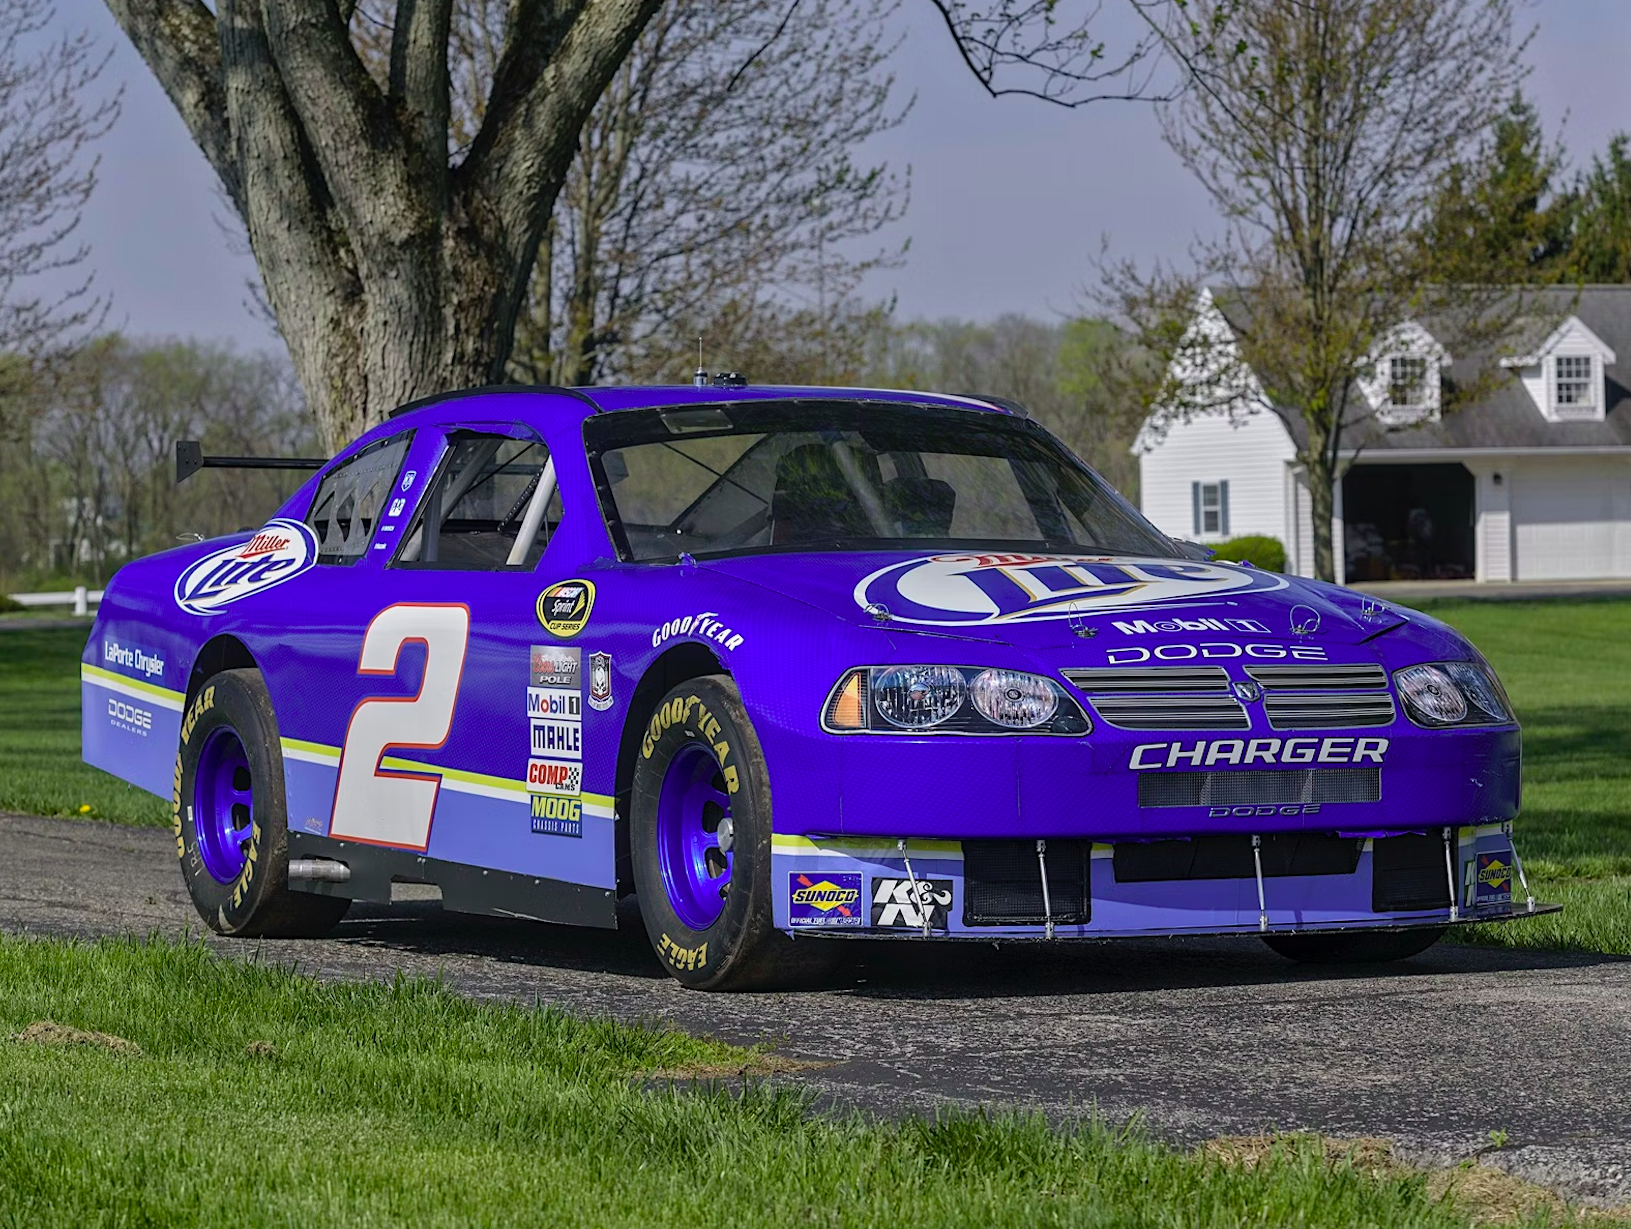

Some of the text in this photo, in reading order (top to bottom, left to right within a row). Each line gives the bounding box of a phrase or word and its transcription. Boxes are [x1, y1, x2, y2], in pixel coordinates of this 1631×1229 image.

[236, 533, 290, 559] Miller
[181, 554, 296, 602] Lite
[551, 599, 576, 617] Sprint
[549, 622, 581, 631] CUP SERIES
[651, 611, 745, 652] GOODYEAR
[1111, 618, 1230, 635] Mobil
[105, 640, 164, 677] LaPorte Chrysler
[1106, 642, 1328, 664] DODGE
[554, 659, 578, 674] LIGHT
[539, 674, 572, 685] POLE
[108, 698, 152, 730] DODGE
[528, 692, 566, 715] Mobil
[569, 695, 580, 715] 1
[110, 718, 148, 737] DEALERS
[328, 602, 471, 854] 2
[533, 724, 580, 752] MAHLE
[642, 694, 741, 796] GOODYEAR
[1128, 737, 1389, 770] CHARGER
[528, 763, 569, 786] COMP
[555, 782, 576, 792] CAMS
[531, 796, 581, 822] MOOG
[1208, 803, 1321, 818] DODGE
[532, 819, 580, 835] CHASSIS PARTS
[1479, 866, 1511, 881] SUNOCO
[794, 889, 857, 903] SUNOCO
[656, 932, 709, 972] EAGLE
